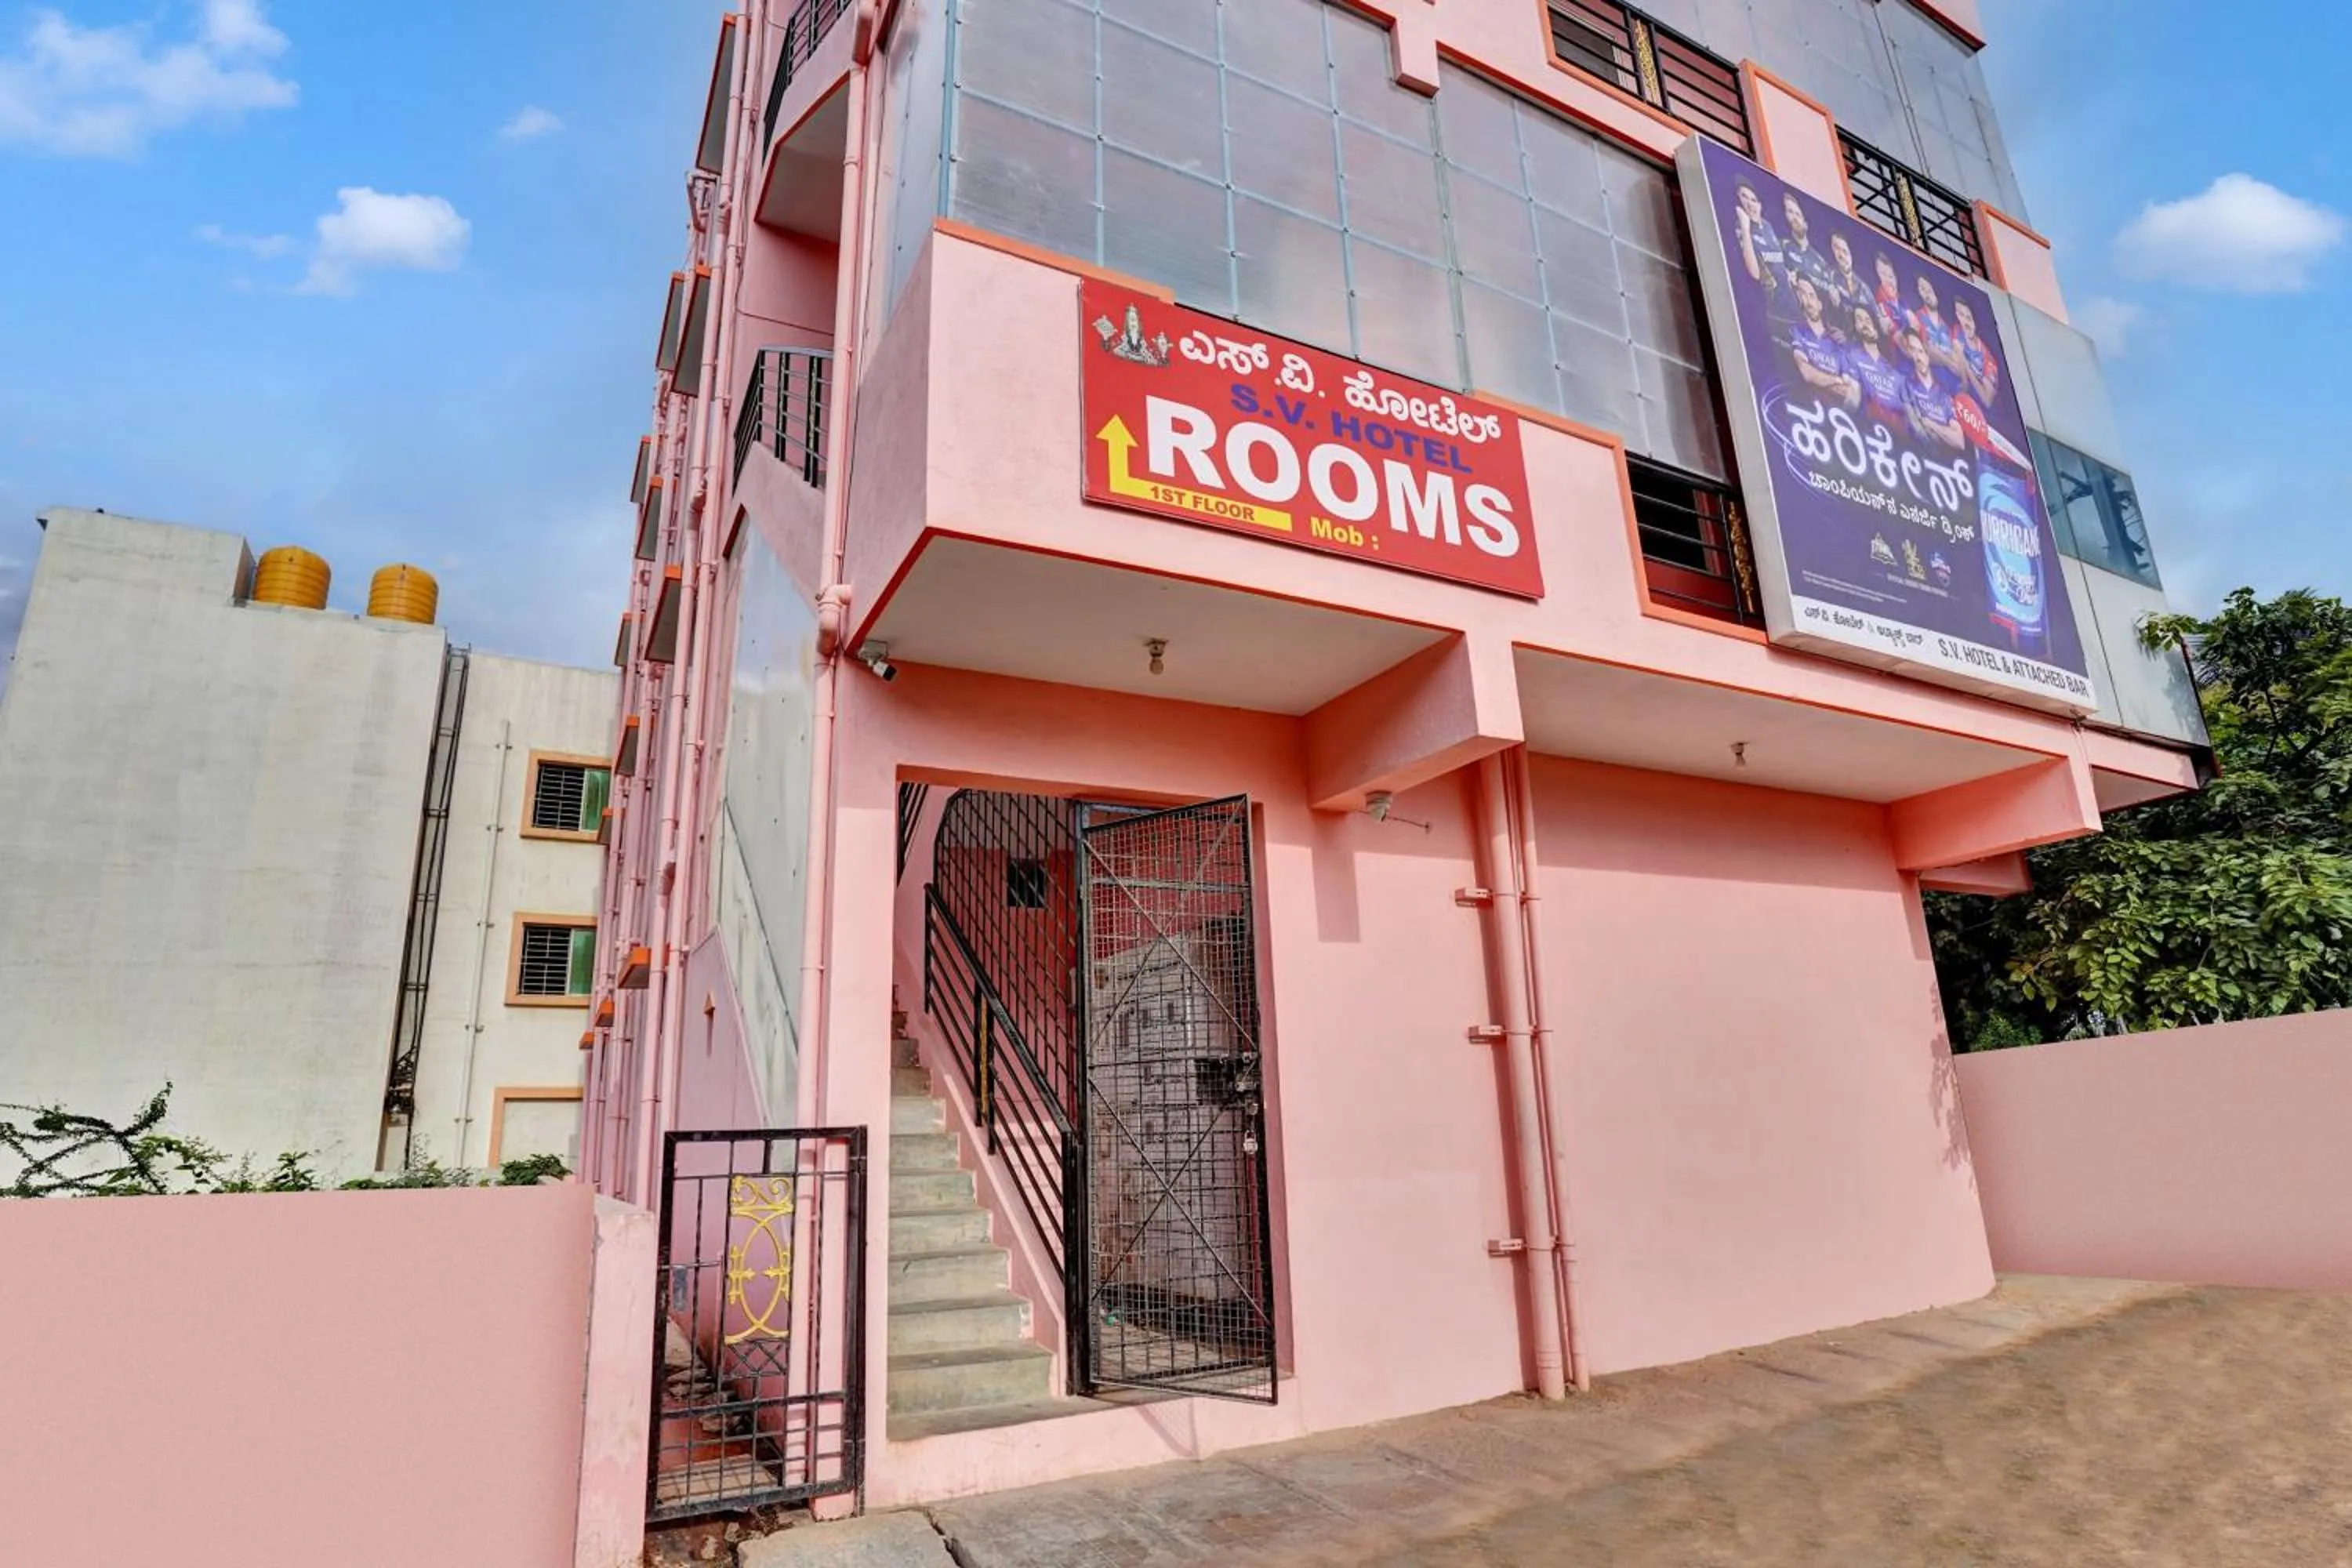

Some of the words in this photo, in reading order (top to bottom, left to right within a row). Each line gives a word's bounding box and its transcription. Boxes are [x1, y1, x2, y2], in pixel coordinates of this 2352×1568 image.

[1230, 383, 1315, 429] S.V.
[1332, 411, 1472, 473] HOTEL
[1343, 370, 1501, 443] ಹೋಟೆಲ್
[1145, 395, 1520, 557] ROOMS
[1785, 400, 1974, 511] ಹರಿಕೇನ್
[1150, 486, 1185, 505] 1ST
[1192, 495, 1255, 521] FLOOR
[1310, 517, 1363, 547] Mob
[1938, 638, 1962, 661] S.V.
[1962, 645, 2000, 672] HOTEL
[2001, 655, 2011, 673] &
[2012, 659, 2065, 689] ATTACHED
[2066, 675, 2089, 699] BAR
